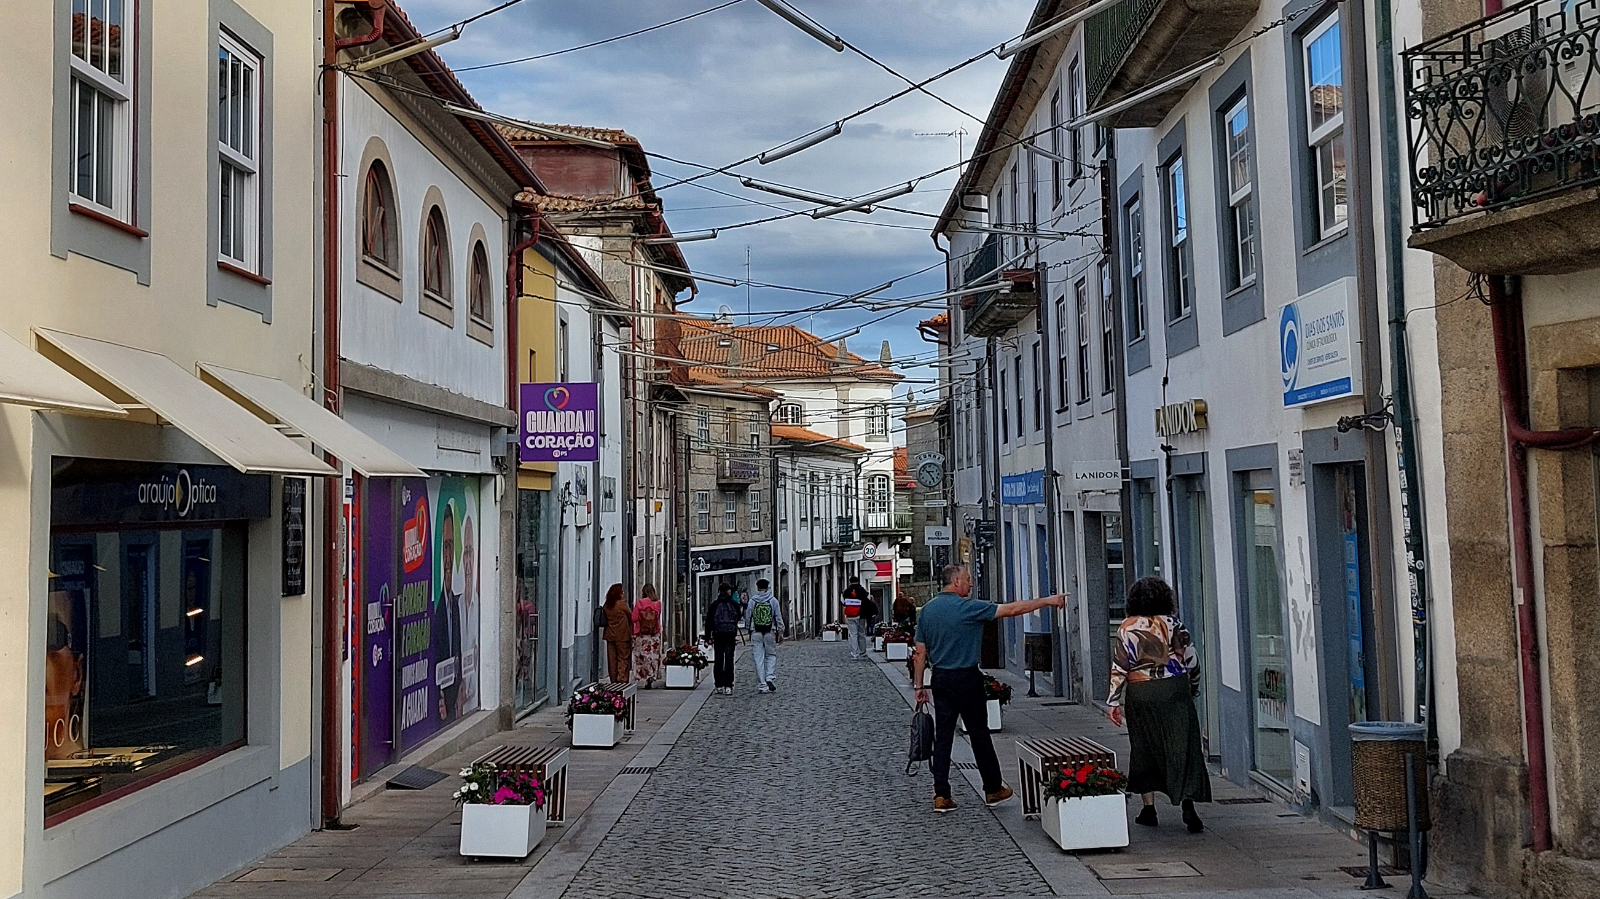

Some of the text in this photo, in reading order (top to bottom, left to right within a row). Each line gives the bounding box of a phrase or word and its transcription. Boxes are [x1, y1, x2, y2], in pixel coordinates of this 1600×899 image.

[1305, 310, 1345, 338] DIAS DOS SANTOS
[526, 410, 594, 433] GUARDA NO
[526, 433, 594, 450] CORAÇÃO
[1075, 471, 1119, 480] LANIDOR
[865, 547, 875, 555] 20
